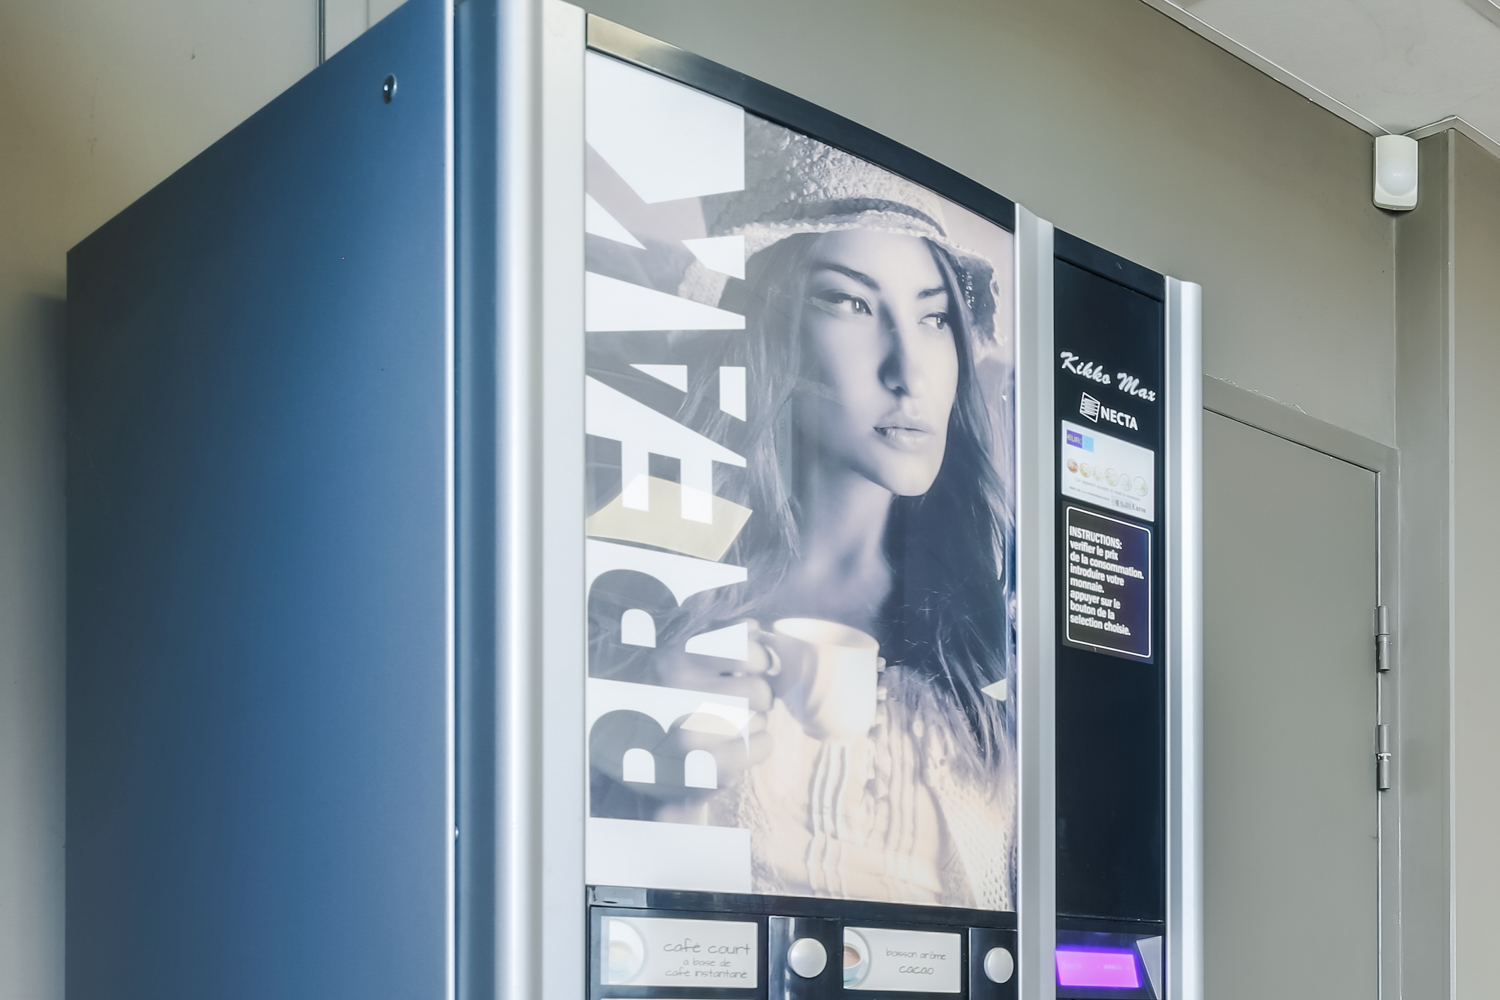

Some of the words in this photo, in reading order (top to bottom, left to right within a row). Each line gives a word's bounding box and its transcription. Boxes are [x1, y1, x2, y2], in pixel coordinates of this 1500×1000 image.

[1060, 351, 1111, 385] Kikko
[1117, 373, 1156, 402] Max
[1101, 406, 1138, 430] NECTA
[586, 141, 749, 822] BREAK
[1070, 526, 1122, 549] INSTRUCTIONS:
[1070, 540, 1095, 554] verifier
[1097, 546, 1103, 556] le
[1105, 550, 1118, 560] prix
[1070, 552, 1080, 562] de
[1081, 554, 1088, 564] la
[1090, 559, 1144, 579] consommation.
[1070, 563, 1105, 581] introduire
[1106, 574, 1124, 586] votre
[1070, 577, 1104, 593] monnaie.
[1070, 590, 1099, 604] appuyer
[1101, 597, 1112, 607] sur
[1114, 599, 1120, 609] le
[1070, 601, 1095, 615] bouton
[1097, 607, 1106, 618] de
[1108, 610, 1115, 620] la
[1070, 614, 1103, 629] selection
[1104, 622, 1131, 635] choisie.
[663, 938, 701, 952] café
[708, 943, 750, 955] court
[899, 965, 934, 974] cacao
